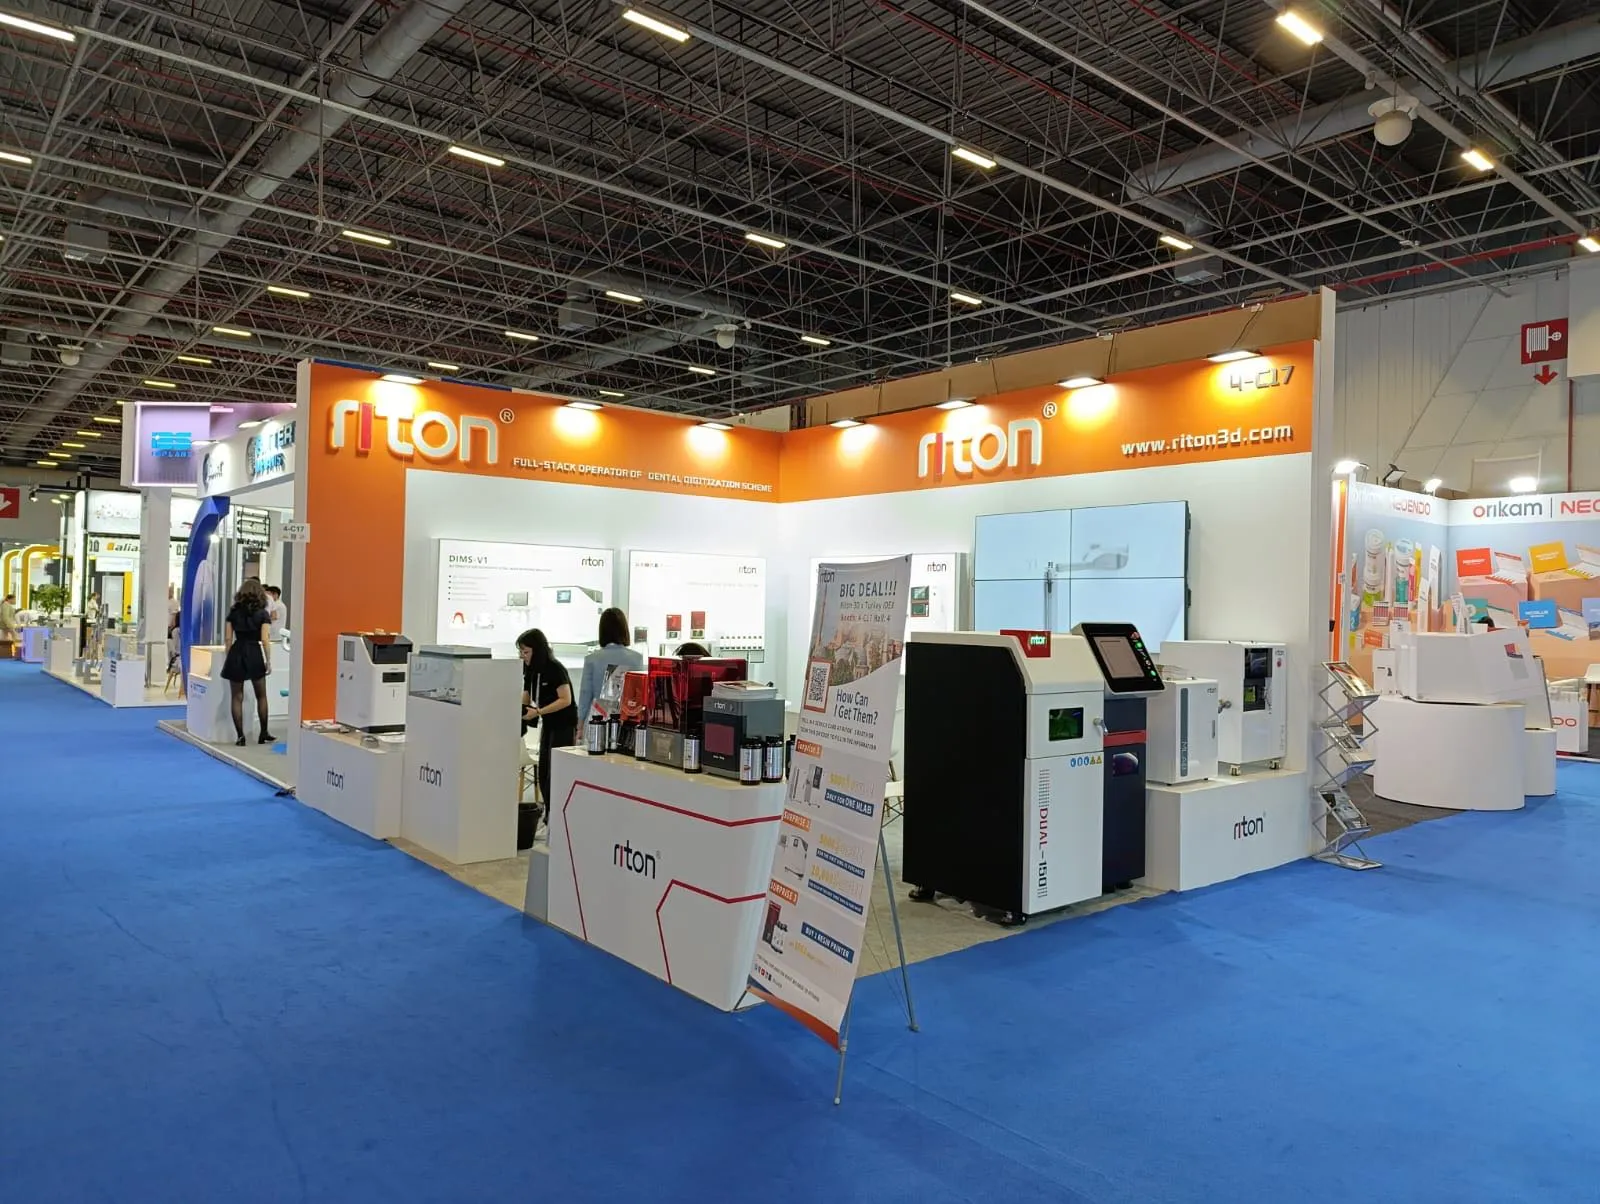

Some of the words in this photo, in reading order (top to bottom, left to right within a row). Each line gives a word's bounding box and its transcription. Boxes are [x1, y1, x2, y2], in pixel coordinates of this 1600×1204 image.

[1230, 365, 1295, 391] 4-C17
[1121, 425, 1292, 455] www.riton3d.com
[513, 457, 576, 472] FULL-STACK
[578, 464, 629, 478] OPERATOR
[630, 470, 642, 478] OF
[648, 472, 682, 483] DENTAL
[683, 476, 741, 489] DIGITIZATION
[741, 482, 772, 492] SCHEME
[1473, 501, 1543, 517] orikam
[449, 555, 488, 564] DIMS-V1
[581, 556, 604, 567] riton
[840, 583, 855, 597] BIG
[859, 580, 897, 597] DEAL!!!
[836, 688, 854, 704] How
[855, 692, 869, 707] Can
[834, 704, 838, 717] I
[838, 705, 852, 720] Get
[853, 708, 879, 725] Them?
[326, 768, 344, 790] riton
[419, 763, 442, 787] riton
[856, 801, 872, 814] MLAB
[1233, 816, 1263, 840] riton
[1038, 808, 1048, 887] DUAL-150
[614, 840, 655, 879] riton
[771, 881, 793, 900] SURPRISE
[831, 941, 850, 957] PRINTER
